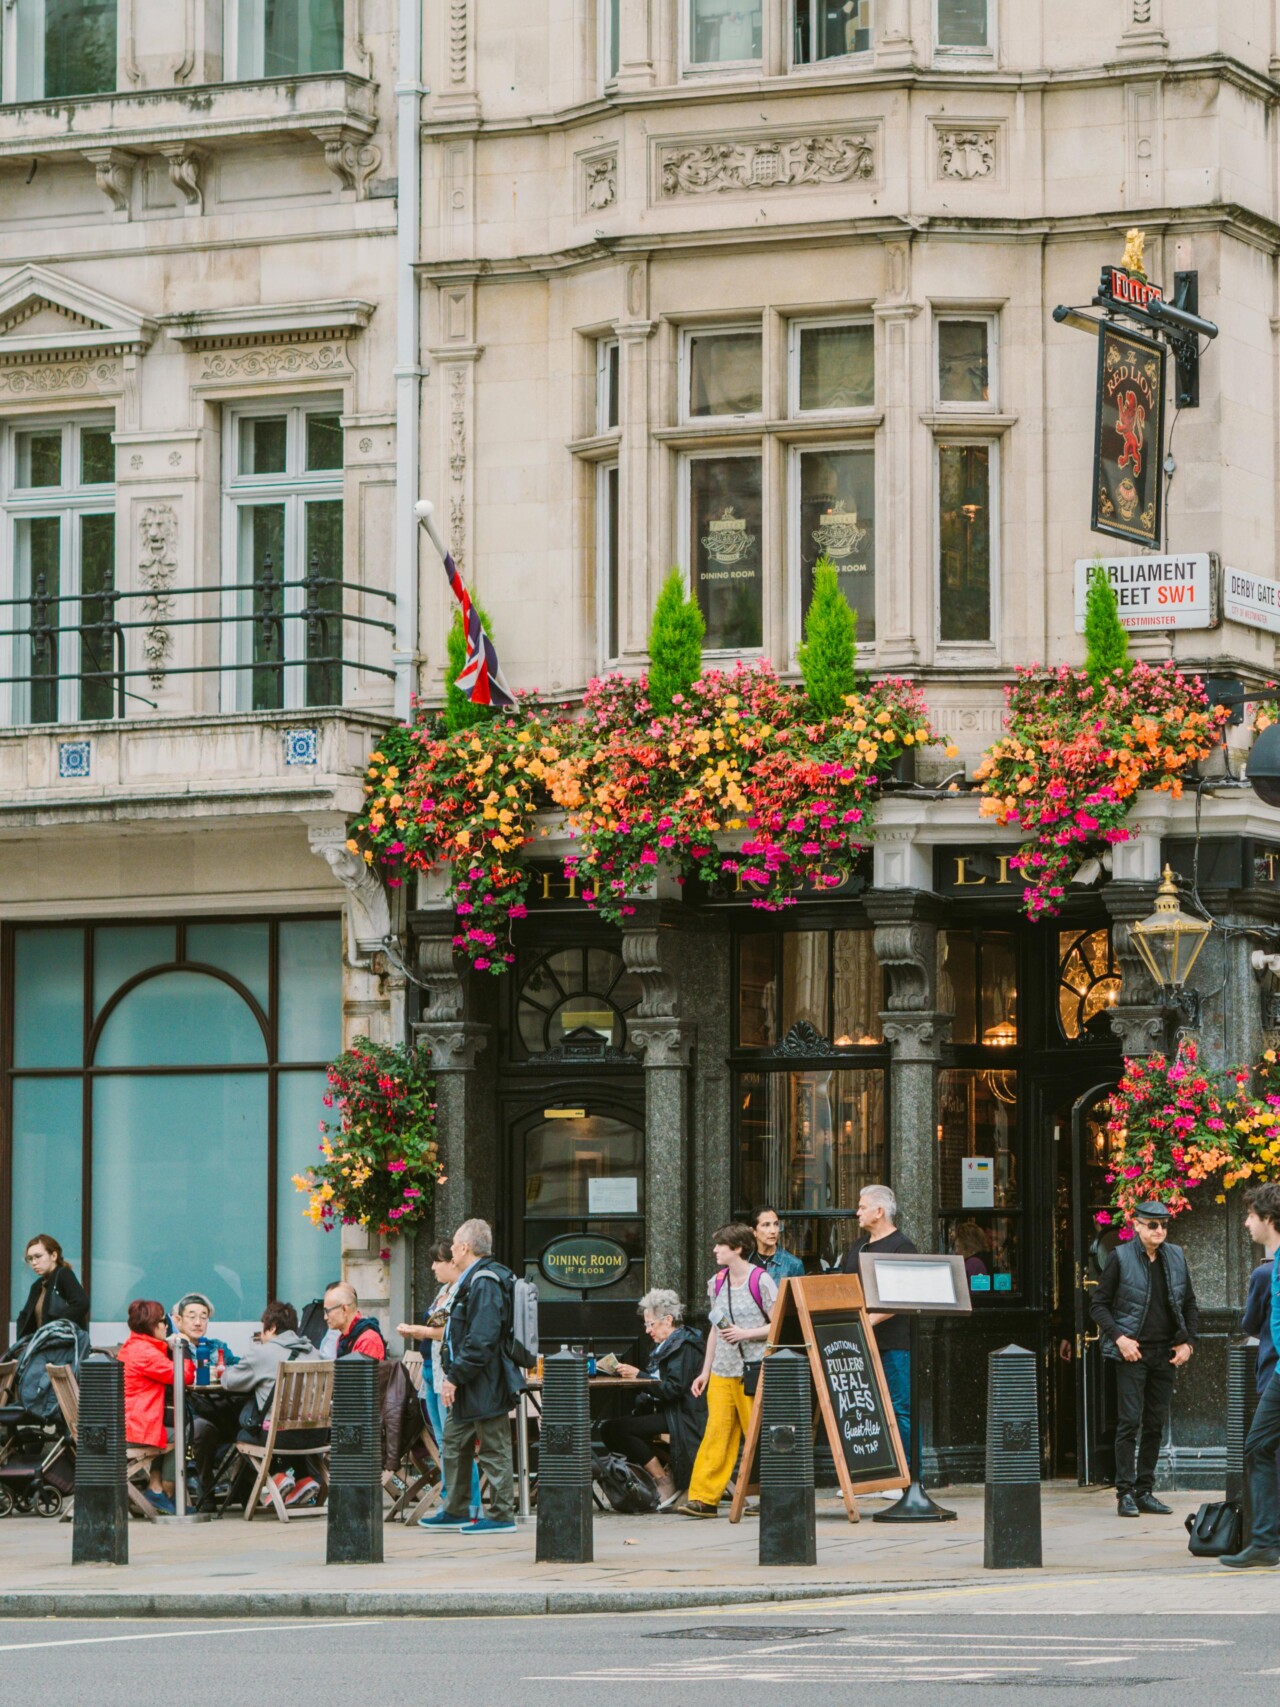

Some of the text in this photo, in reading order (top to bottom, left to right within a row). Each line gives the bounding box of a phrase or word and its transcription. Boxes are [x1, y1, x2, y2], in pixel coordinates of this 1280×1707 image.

[1125, 350, 1138, 365] The
[1107, 365, 1155, 410] RED LION
[700, 570, 755, 580] DINING ROOM
[842, 564, 867, 572] ROOM
[1086, 562, 1197, 585] PARLIAMENT
[1157, 585, 1195, 605] SW1
[1231, 575, 1255, 599] DERBY
[1257, 584, 1275, 606] GATE
[1121, 616, 1176, 627] WESTMINSTER
[547, 1254, 622, 1266] DINING ROOM
[823, 1340, 861, 1357] TRADITIONAL
[829, 1371, 869, 1392] REAL
[838, 1389, 875, 1419] ALES
[856, 1409, 863, 1421] &
[844, 1419, 880, 1441] Guest Ales
[853, 1440, 879, 1455] ON TAP
